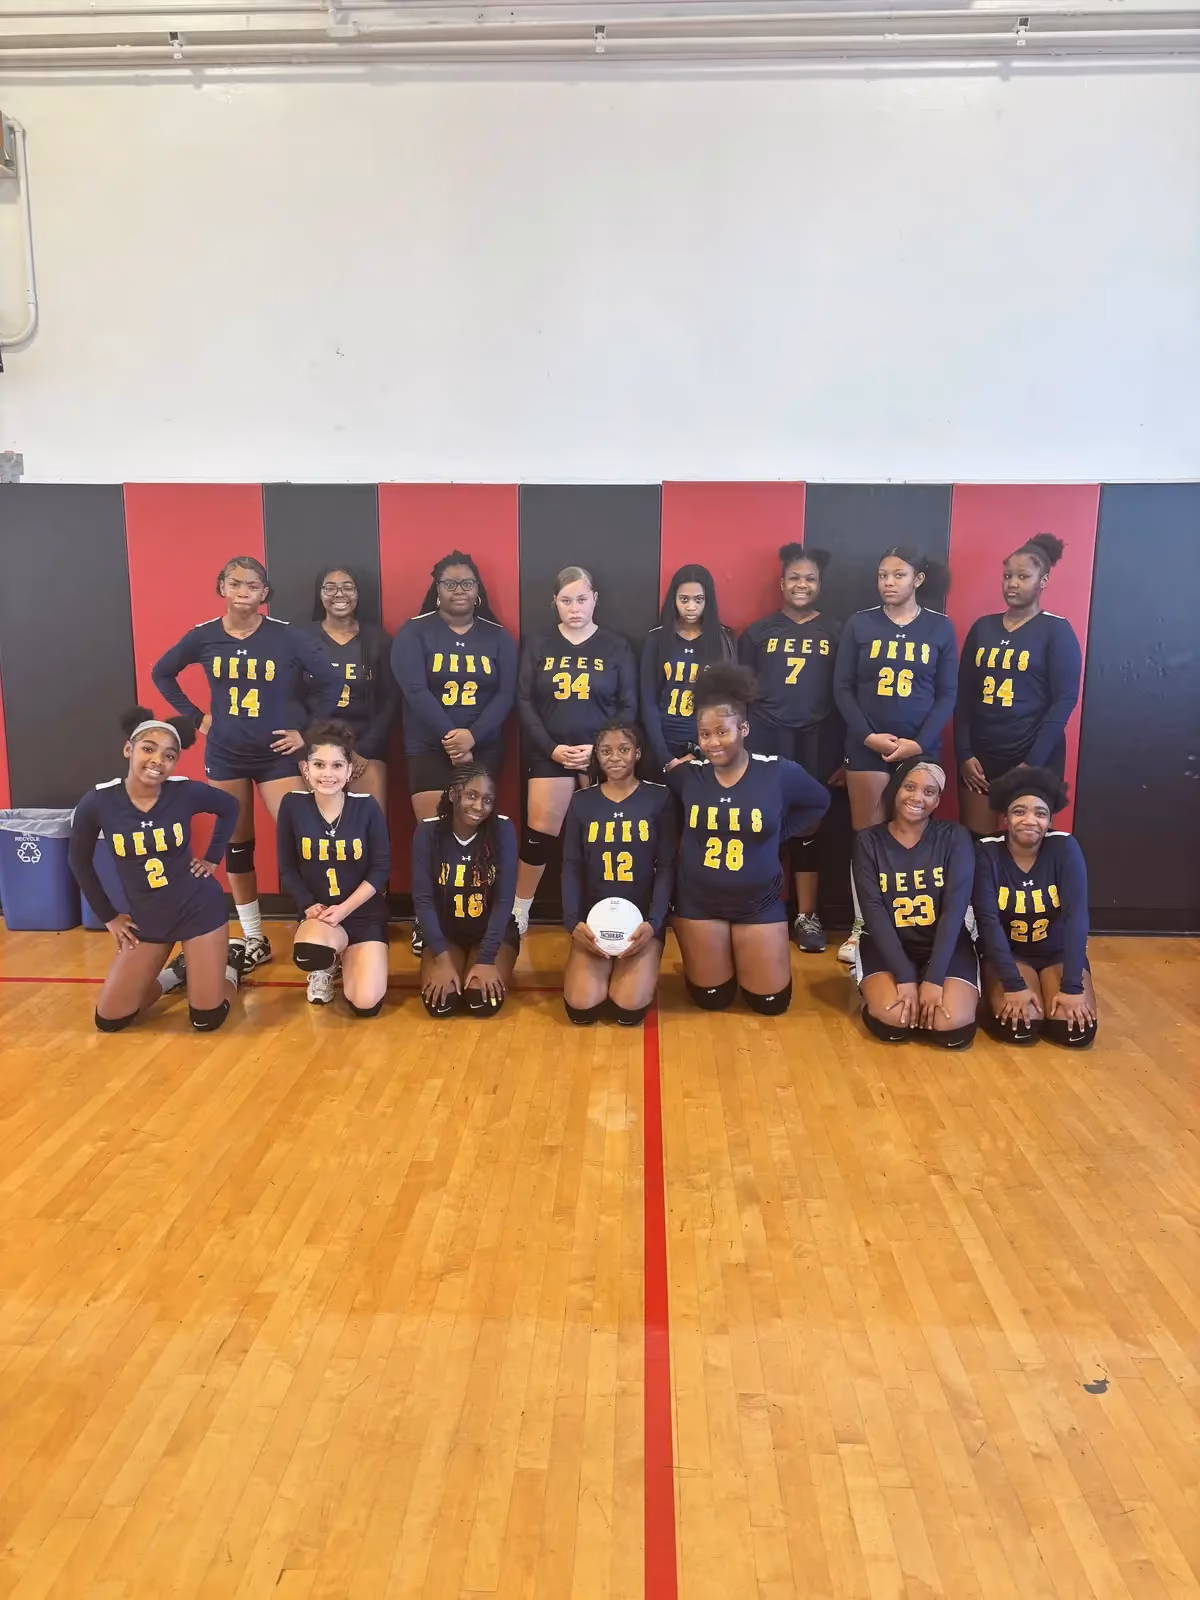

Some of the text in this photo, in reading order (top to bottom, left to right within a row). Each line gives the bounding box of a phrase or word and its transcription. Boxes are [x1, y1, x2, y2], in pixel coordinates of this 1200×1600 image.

[767, 638, 830, 656] BEES
[543, 656, 604, 671] BEES
[785, 657, 806, 685] 7
[441, 680, 478, 706] 32
[552, 672, 590, 700] 34
[877, 667, 914, 697] 26
[982, 675, 1014, 707] 24
[228, 686, 260, 717] 14
[602, 851, 634, 882] 12
[703, 836, 744, 871] 28
[144, 857, 168, 889] 2
[326, 867, 341, 897] 1
[878, 866, 944, 893] BEES
[453, 892, 484, 918] 16
[892, 894, 936, 928] 23
[1010, 918, 1050, 943] 22
